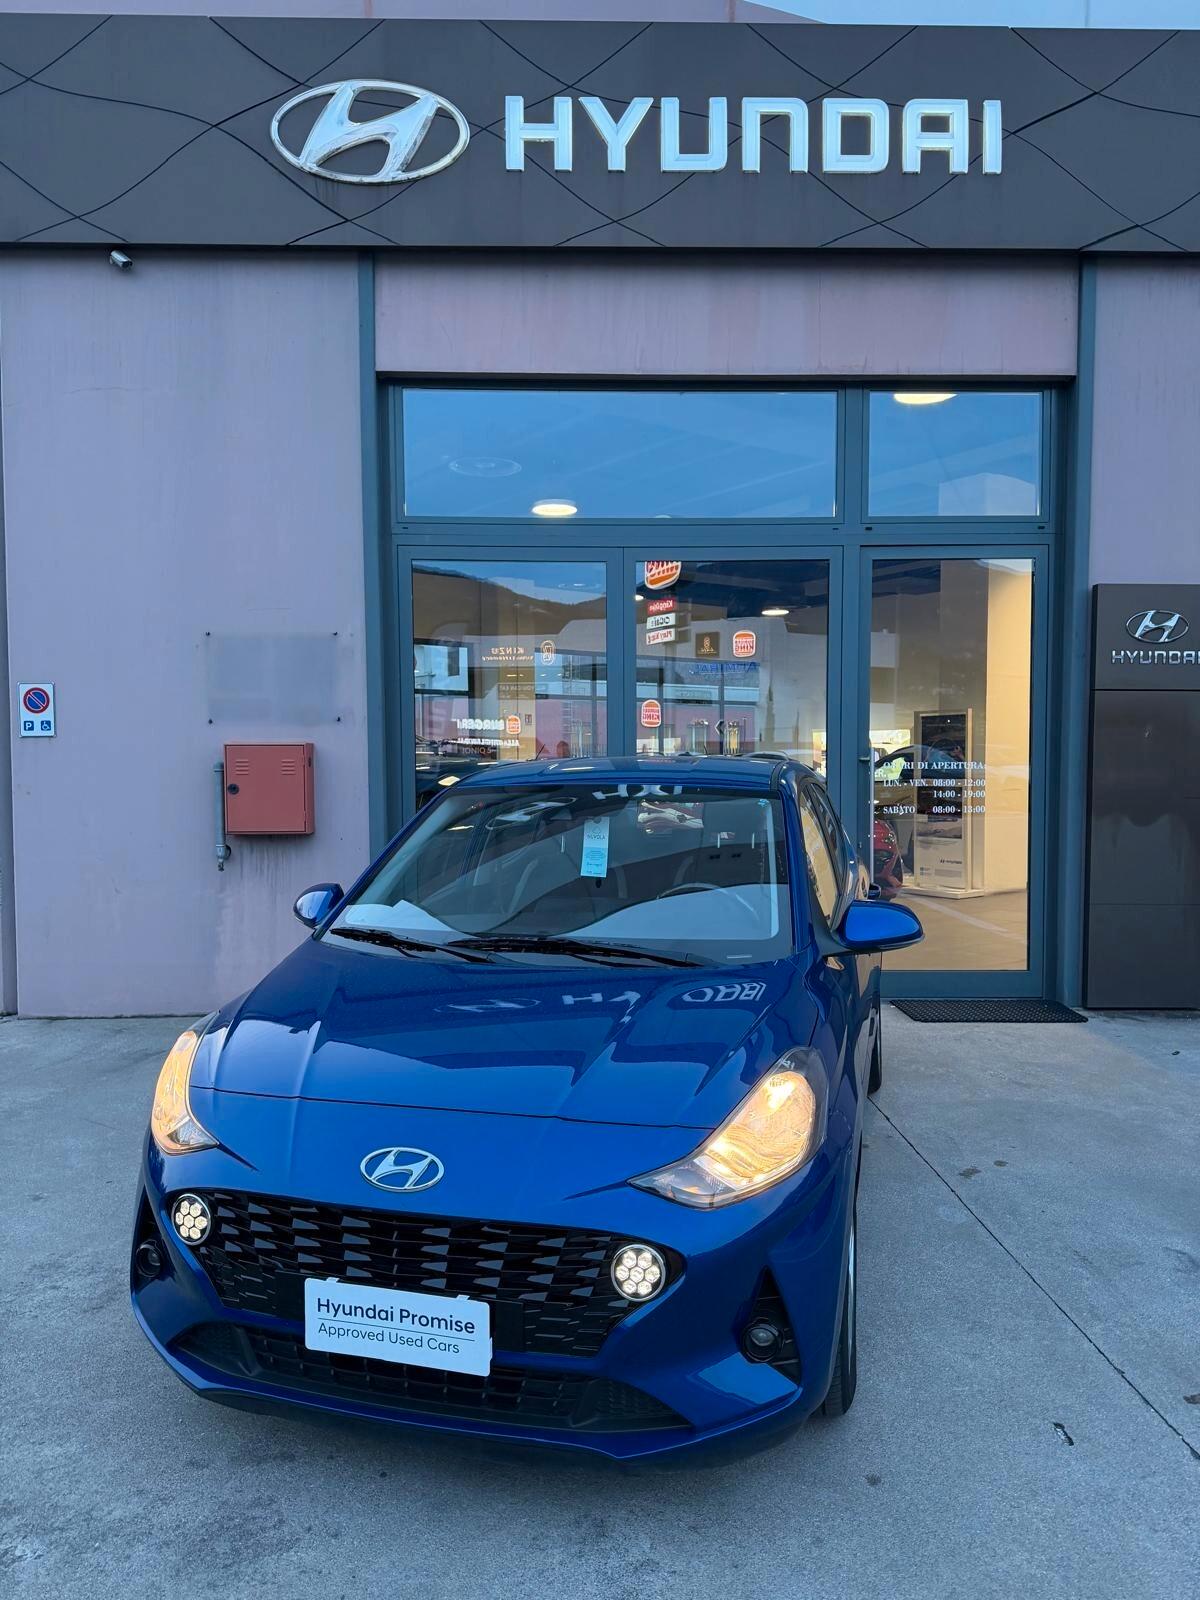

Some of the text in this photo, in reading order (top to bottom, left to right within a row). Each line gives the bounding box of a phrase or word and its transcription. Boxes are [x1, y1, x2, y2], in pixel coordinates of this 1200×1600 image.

[505, 96, 1002, 174] HYUNDAI
[917, 761, 928, 770] DI
[883, 779, 902, 787] LUN.
[909, 779, 928, 787] VEN.
[933, 779, 956, 787] 08:00
[964, 779, 986, 787] 12:00
[933, 790, 956, 798] 14:00
[883, 806, 916, 814] SABATO
[932, 805, 956, 814] 08:00
[317, 1298, 475, 1334] Hyundai Promise
[318, 1322, 460, 1354] Approved Used Cars
